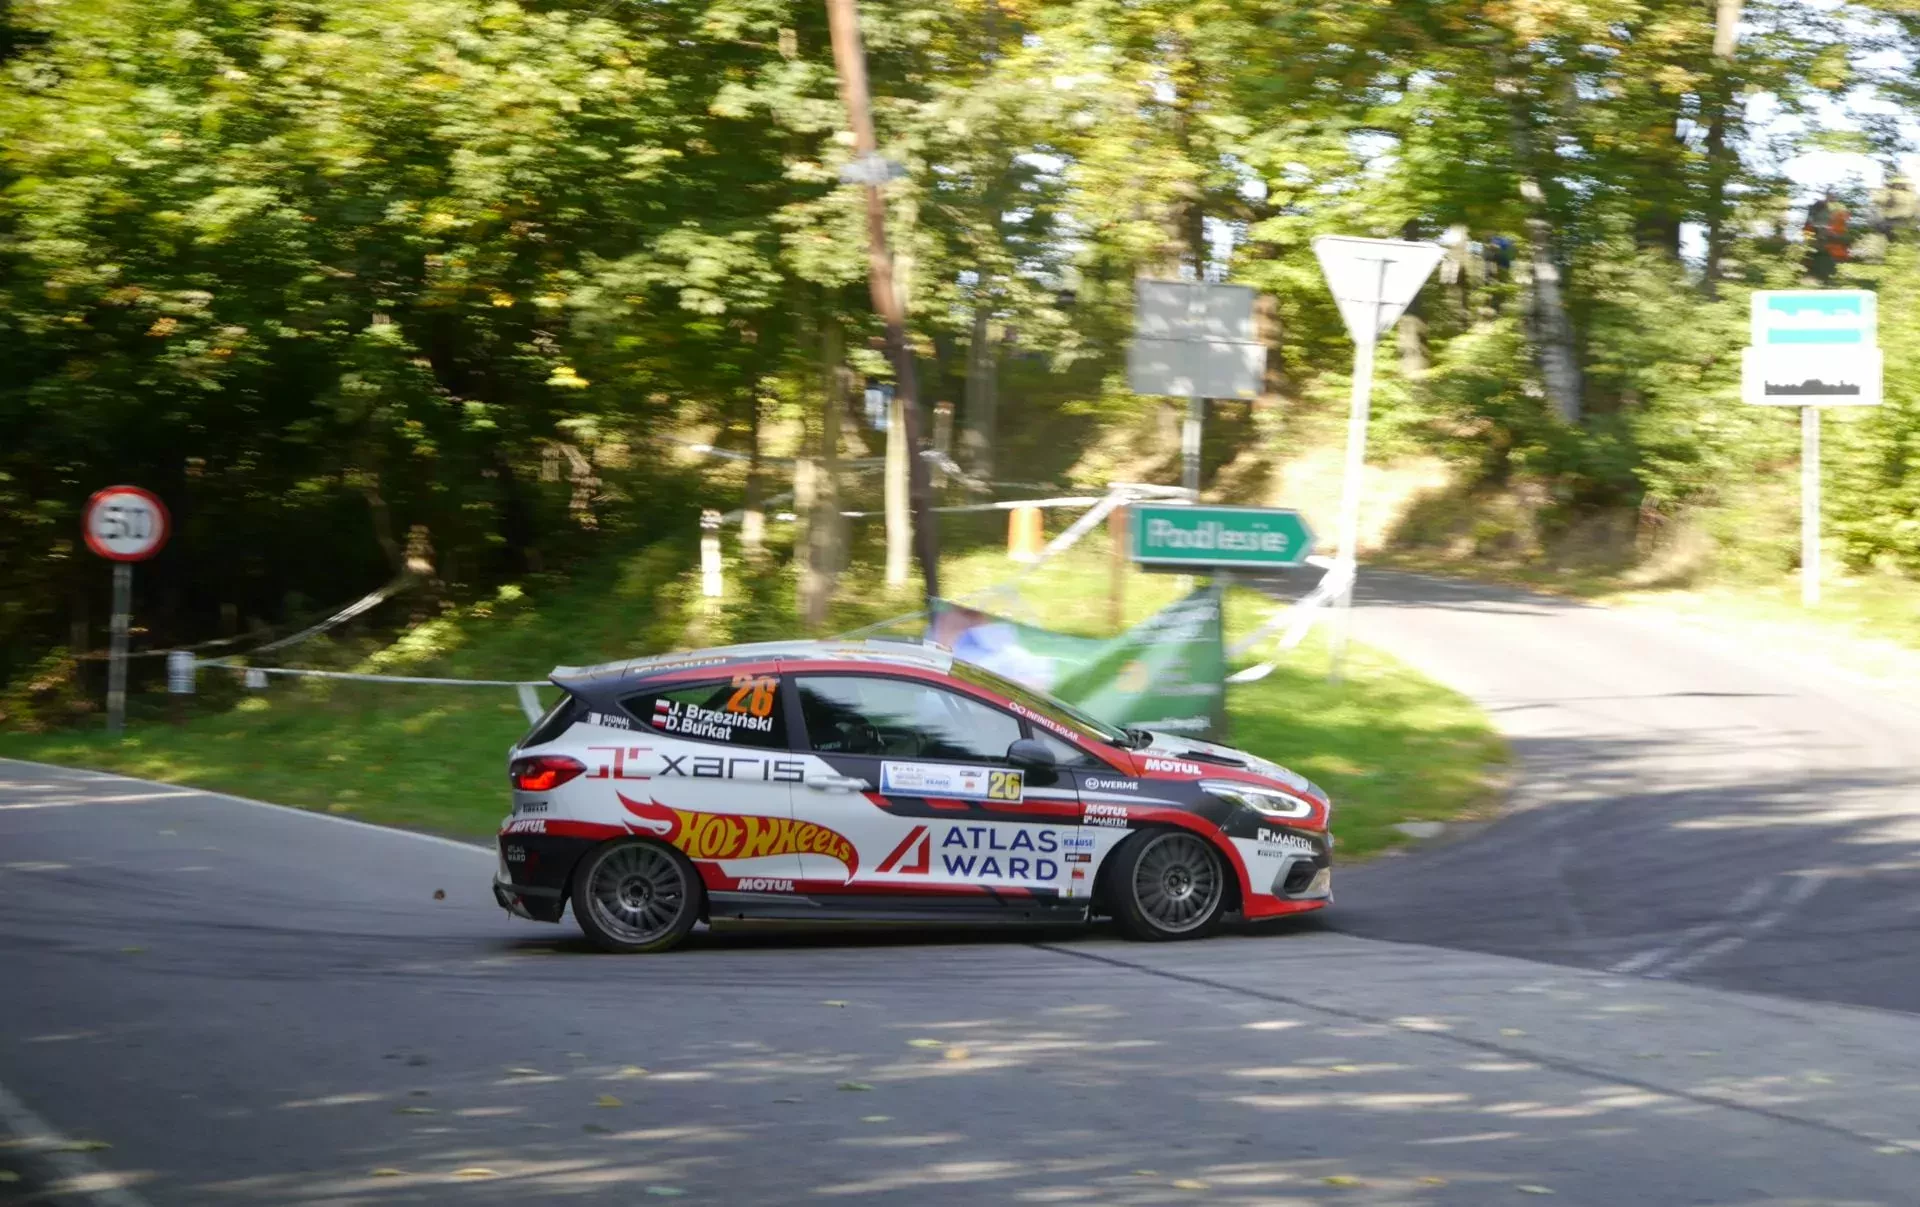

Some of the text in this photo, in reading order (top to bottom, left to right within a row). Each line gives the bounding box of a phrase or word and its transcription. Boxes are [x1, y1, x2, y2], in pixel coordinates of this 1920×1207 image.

[100, 505, 151, 539] 50
[1146, 518, 1290, 553] Podlesie
[727, 674, 777, 717] 26
[668, 702, 772, 732] J. Brzeziński
[1026, 710, 1079, 742] INFINITE SOLAR
[1144, 758, 1202, 775] MOTUL
[989, 771, 1021, 800] 26
[1100, 780, 1139, 791] WERME
[1085, 804, 1128, 817] MOTUL
[1092, 816, 1128, 828] MARTEN
[509, 820, 546, 834] MOTUL
[942, 826, 1058, 853] ATLAS
[1063, 838, 1093, 848] KRAUSE
[1271, 831, 1313, 852] MARTEN
[942, 854, 1058, 881] WARD
[737, 878, 795, 891] MOTUL
